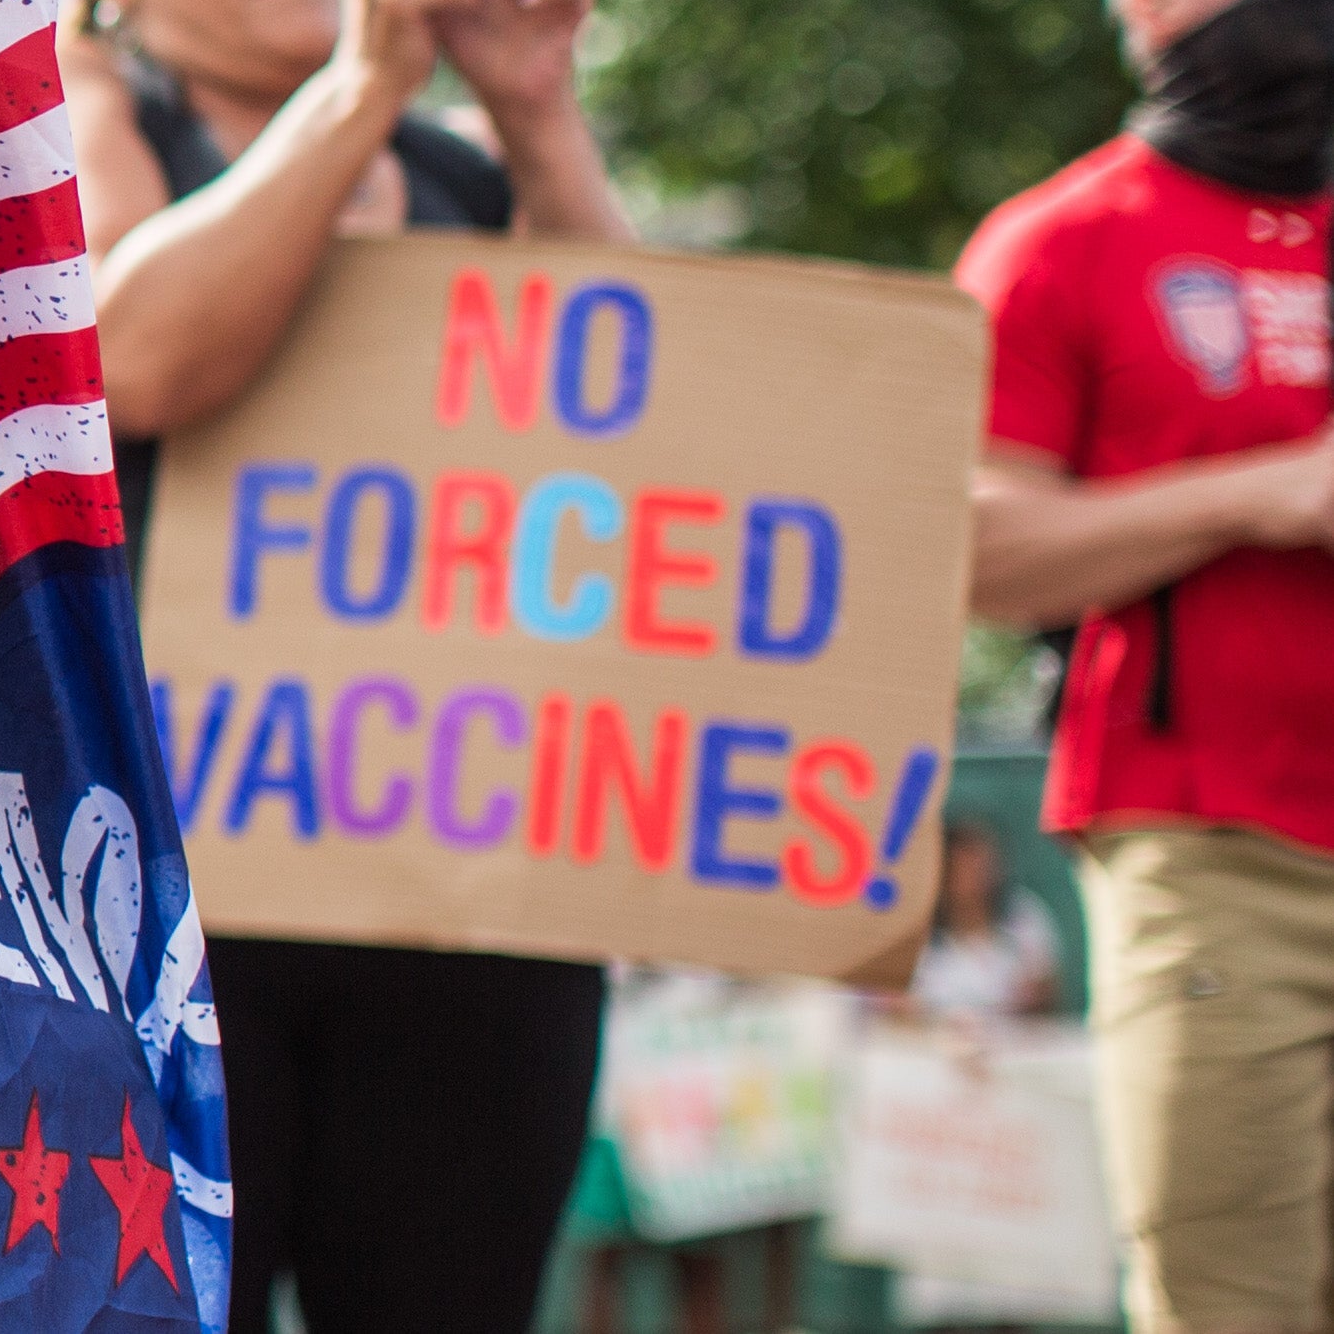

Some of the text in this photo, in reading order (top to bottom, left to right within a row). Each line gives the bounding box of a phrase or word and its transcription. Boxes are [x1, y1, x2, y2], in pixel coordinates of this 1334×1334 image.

[434, 268, 654, 438] NO
[227, 463, 842, 666] FORCED
[150, 676, 938, 913] VACCINES!
